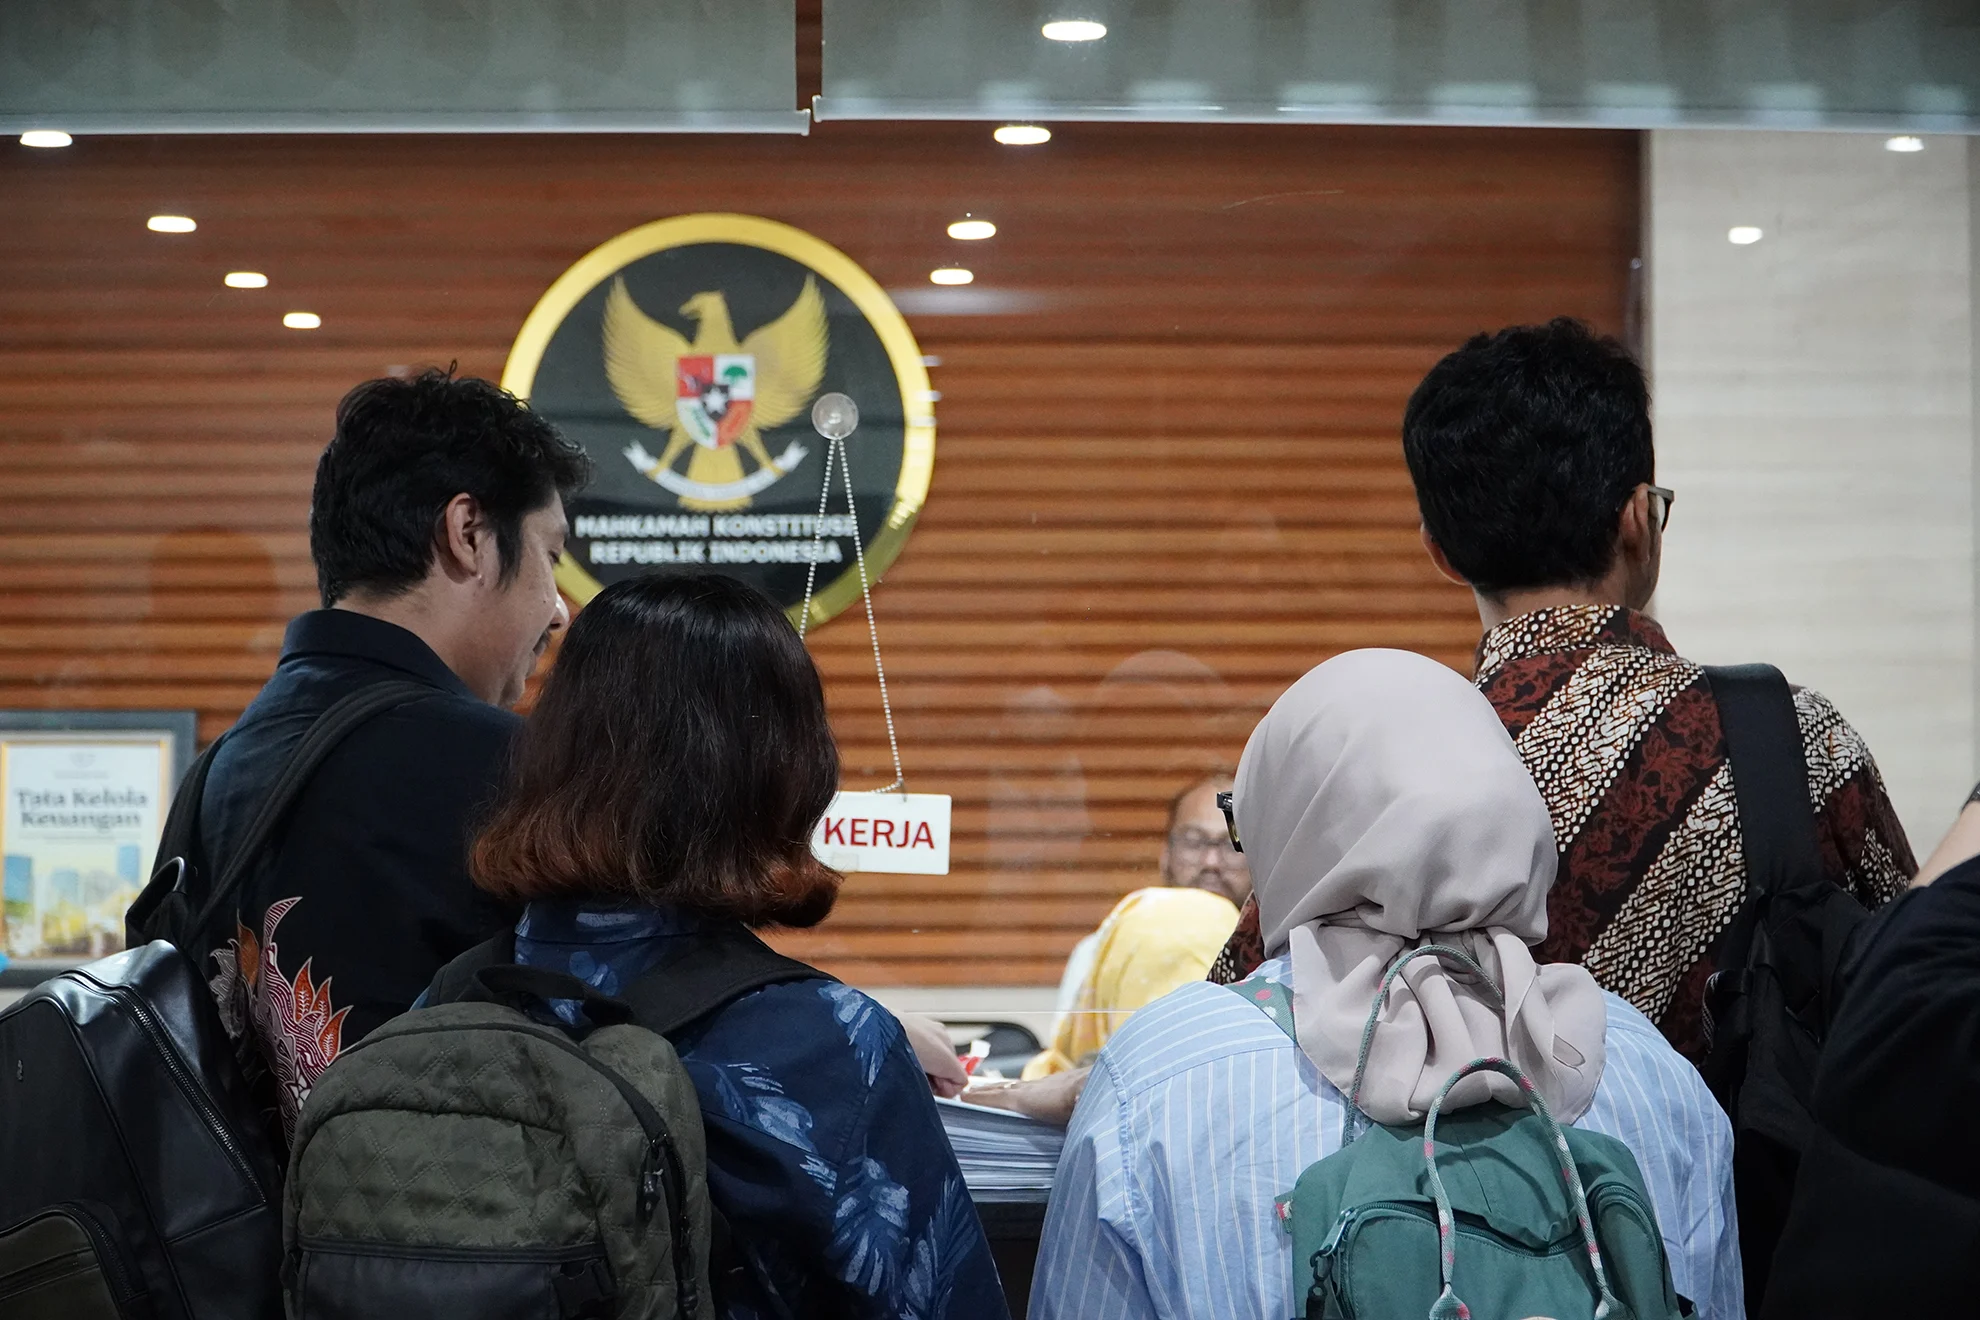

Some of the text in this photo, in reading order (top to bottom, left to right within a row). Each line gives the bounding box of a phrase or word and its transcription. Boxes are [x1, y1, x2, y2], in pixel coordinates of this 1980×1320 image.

[575, 514, 856, 537] MAHKAMAH KONSTITUSI
[590, 540, 843, 563] REPUBLIK INDONESIA
[16, 788, 66, 808] Tata
[21, 811, 142, 832] Keuangan
[824, 817, 935, 849] KERJA
